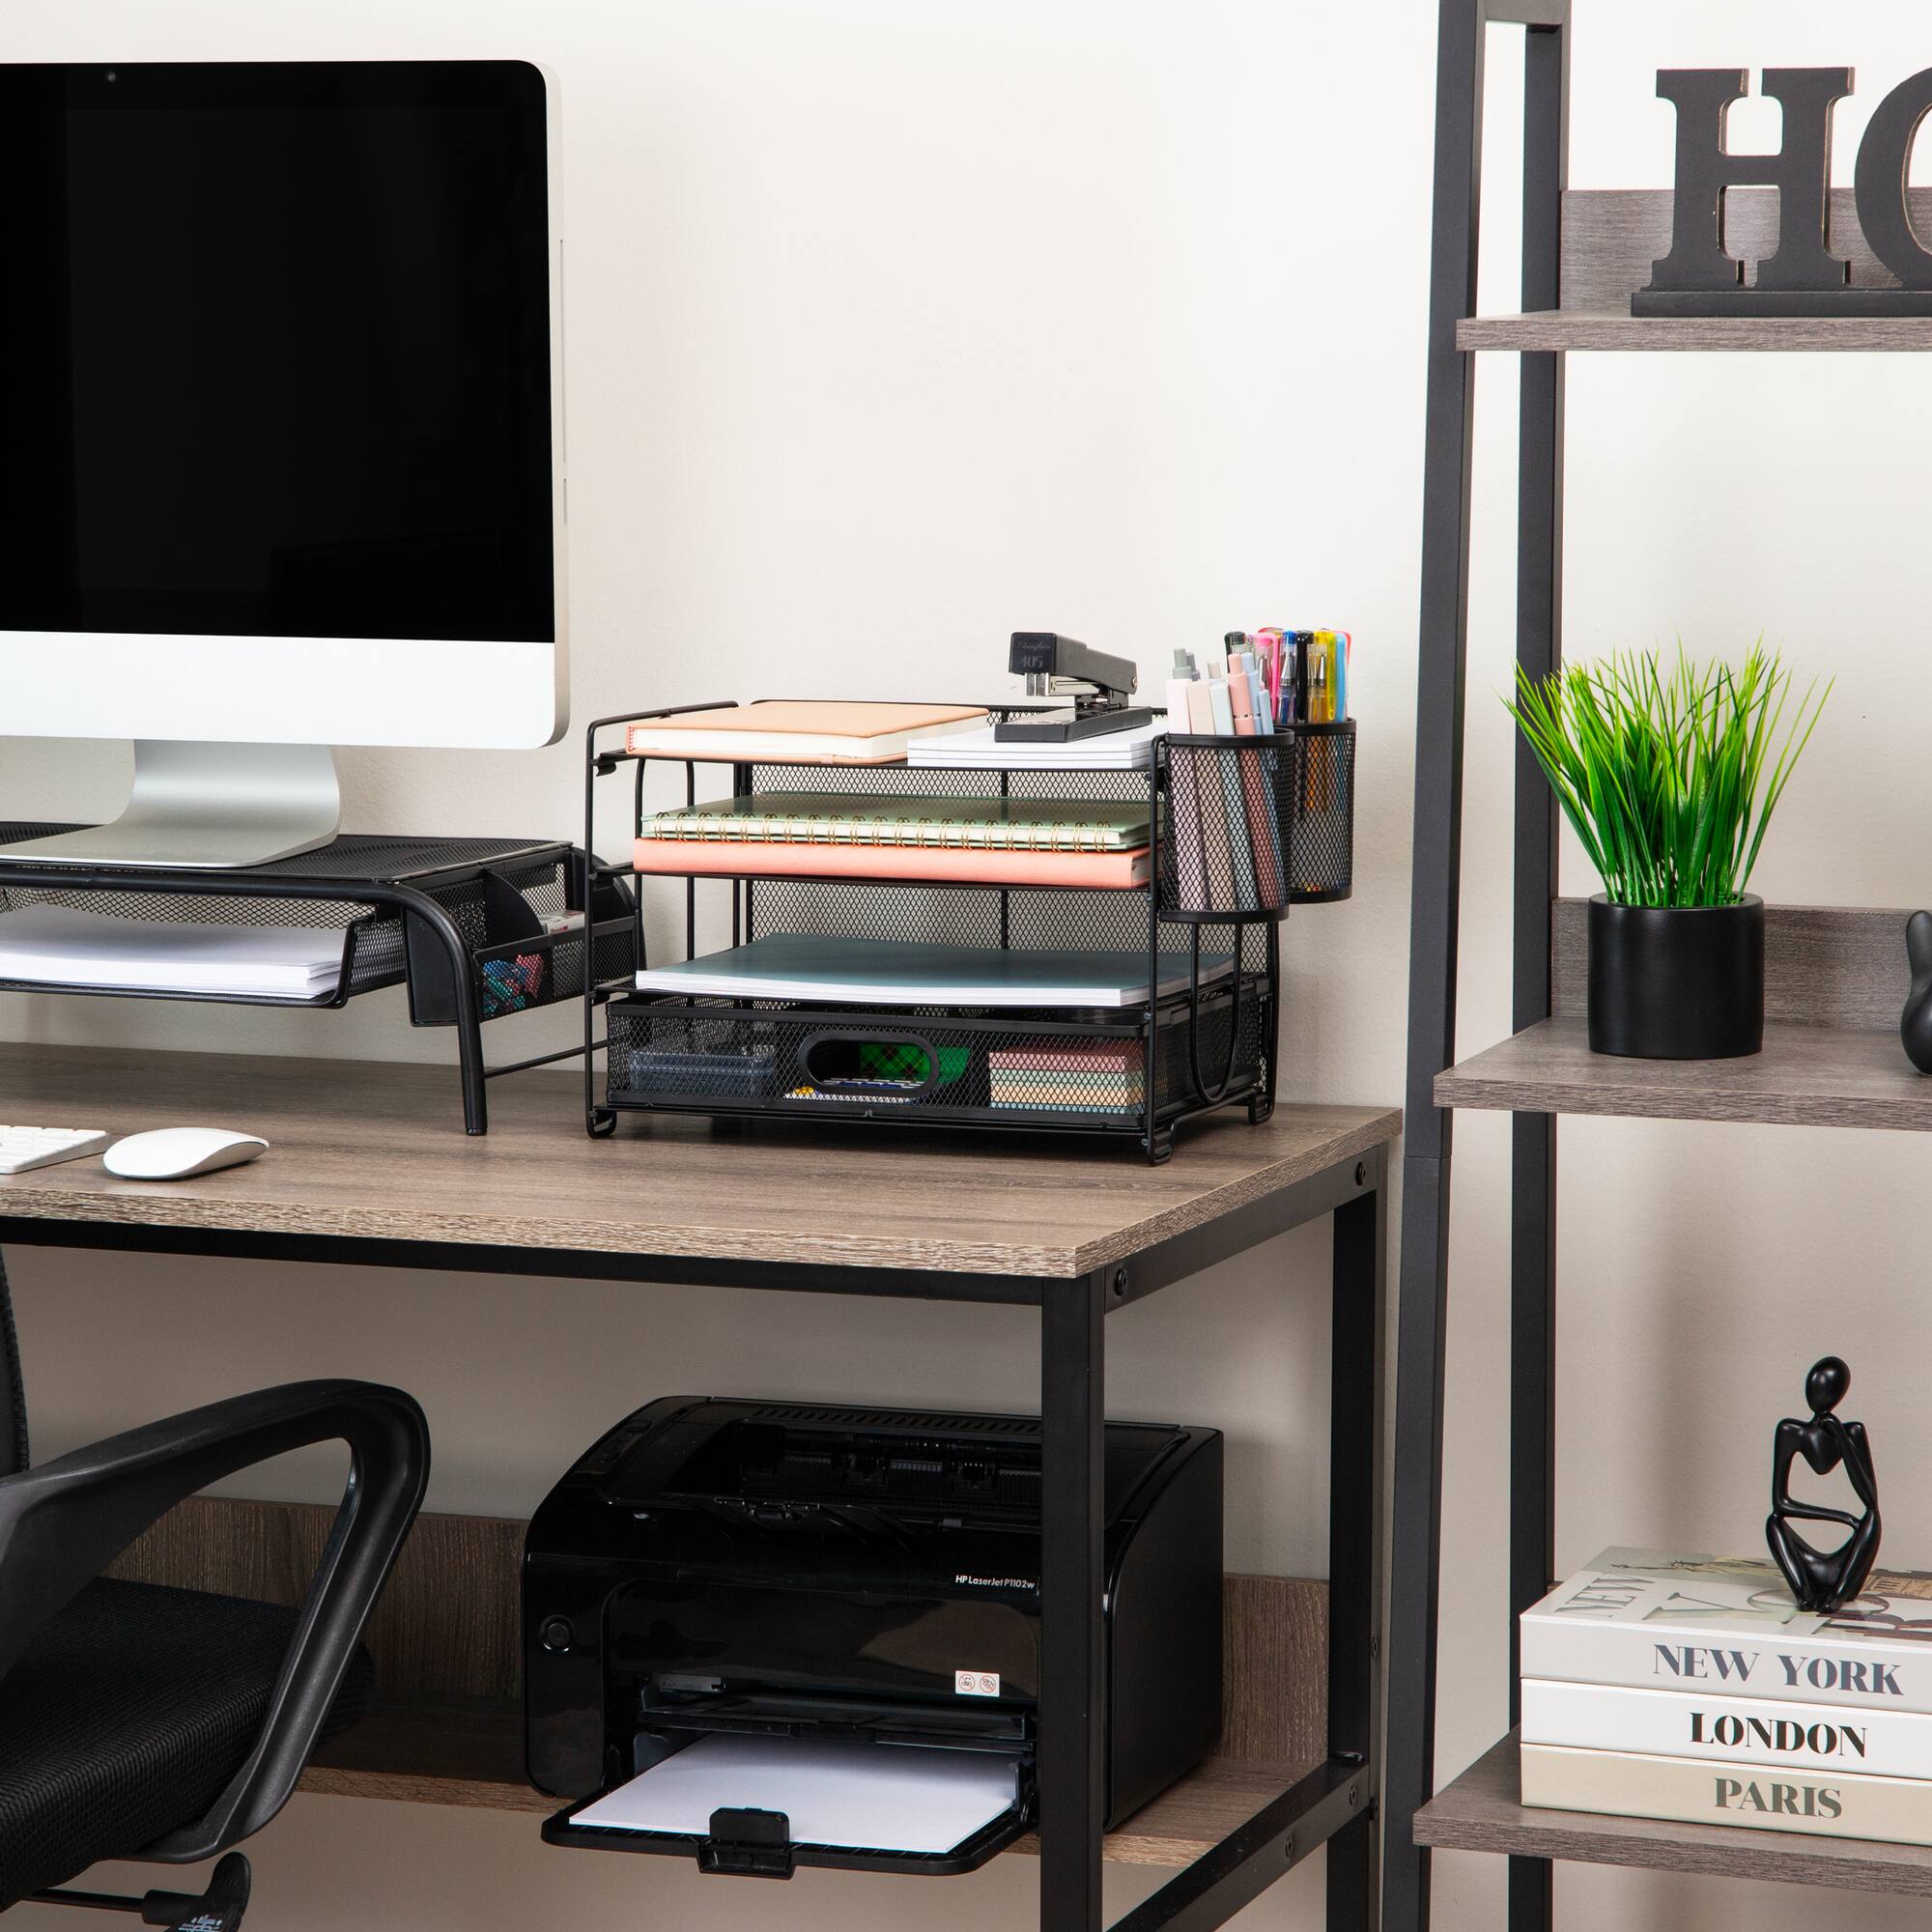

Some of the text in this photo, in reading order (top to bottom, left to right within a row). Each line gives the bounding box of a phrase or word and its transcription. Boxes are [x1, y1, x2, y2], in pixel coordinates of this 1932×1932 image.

[955, 1575, 1035, 1589] HP LaserJet P1102w
[1653, 1643, 1905, 1696] NEW YORK
[1689, 1712, 1868, 1758] LONDON
[1714, 1776, 1842, 1819] PARIS
